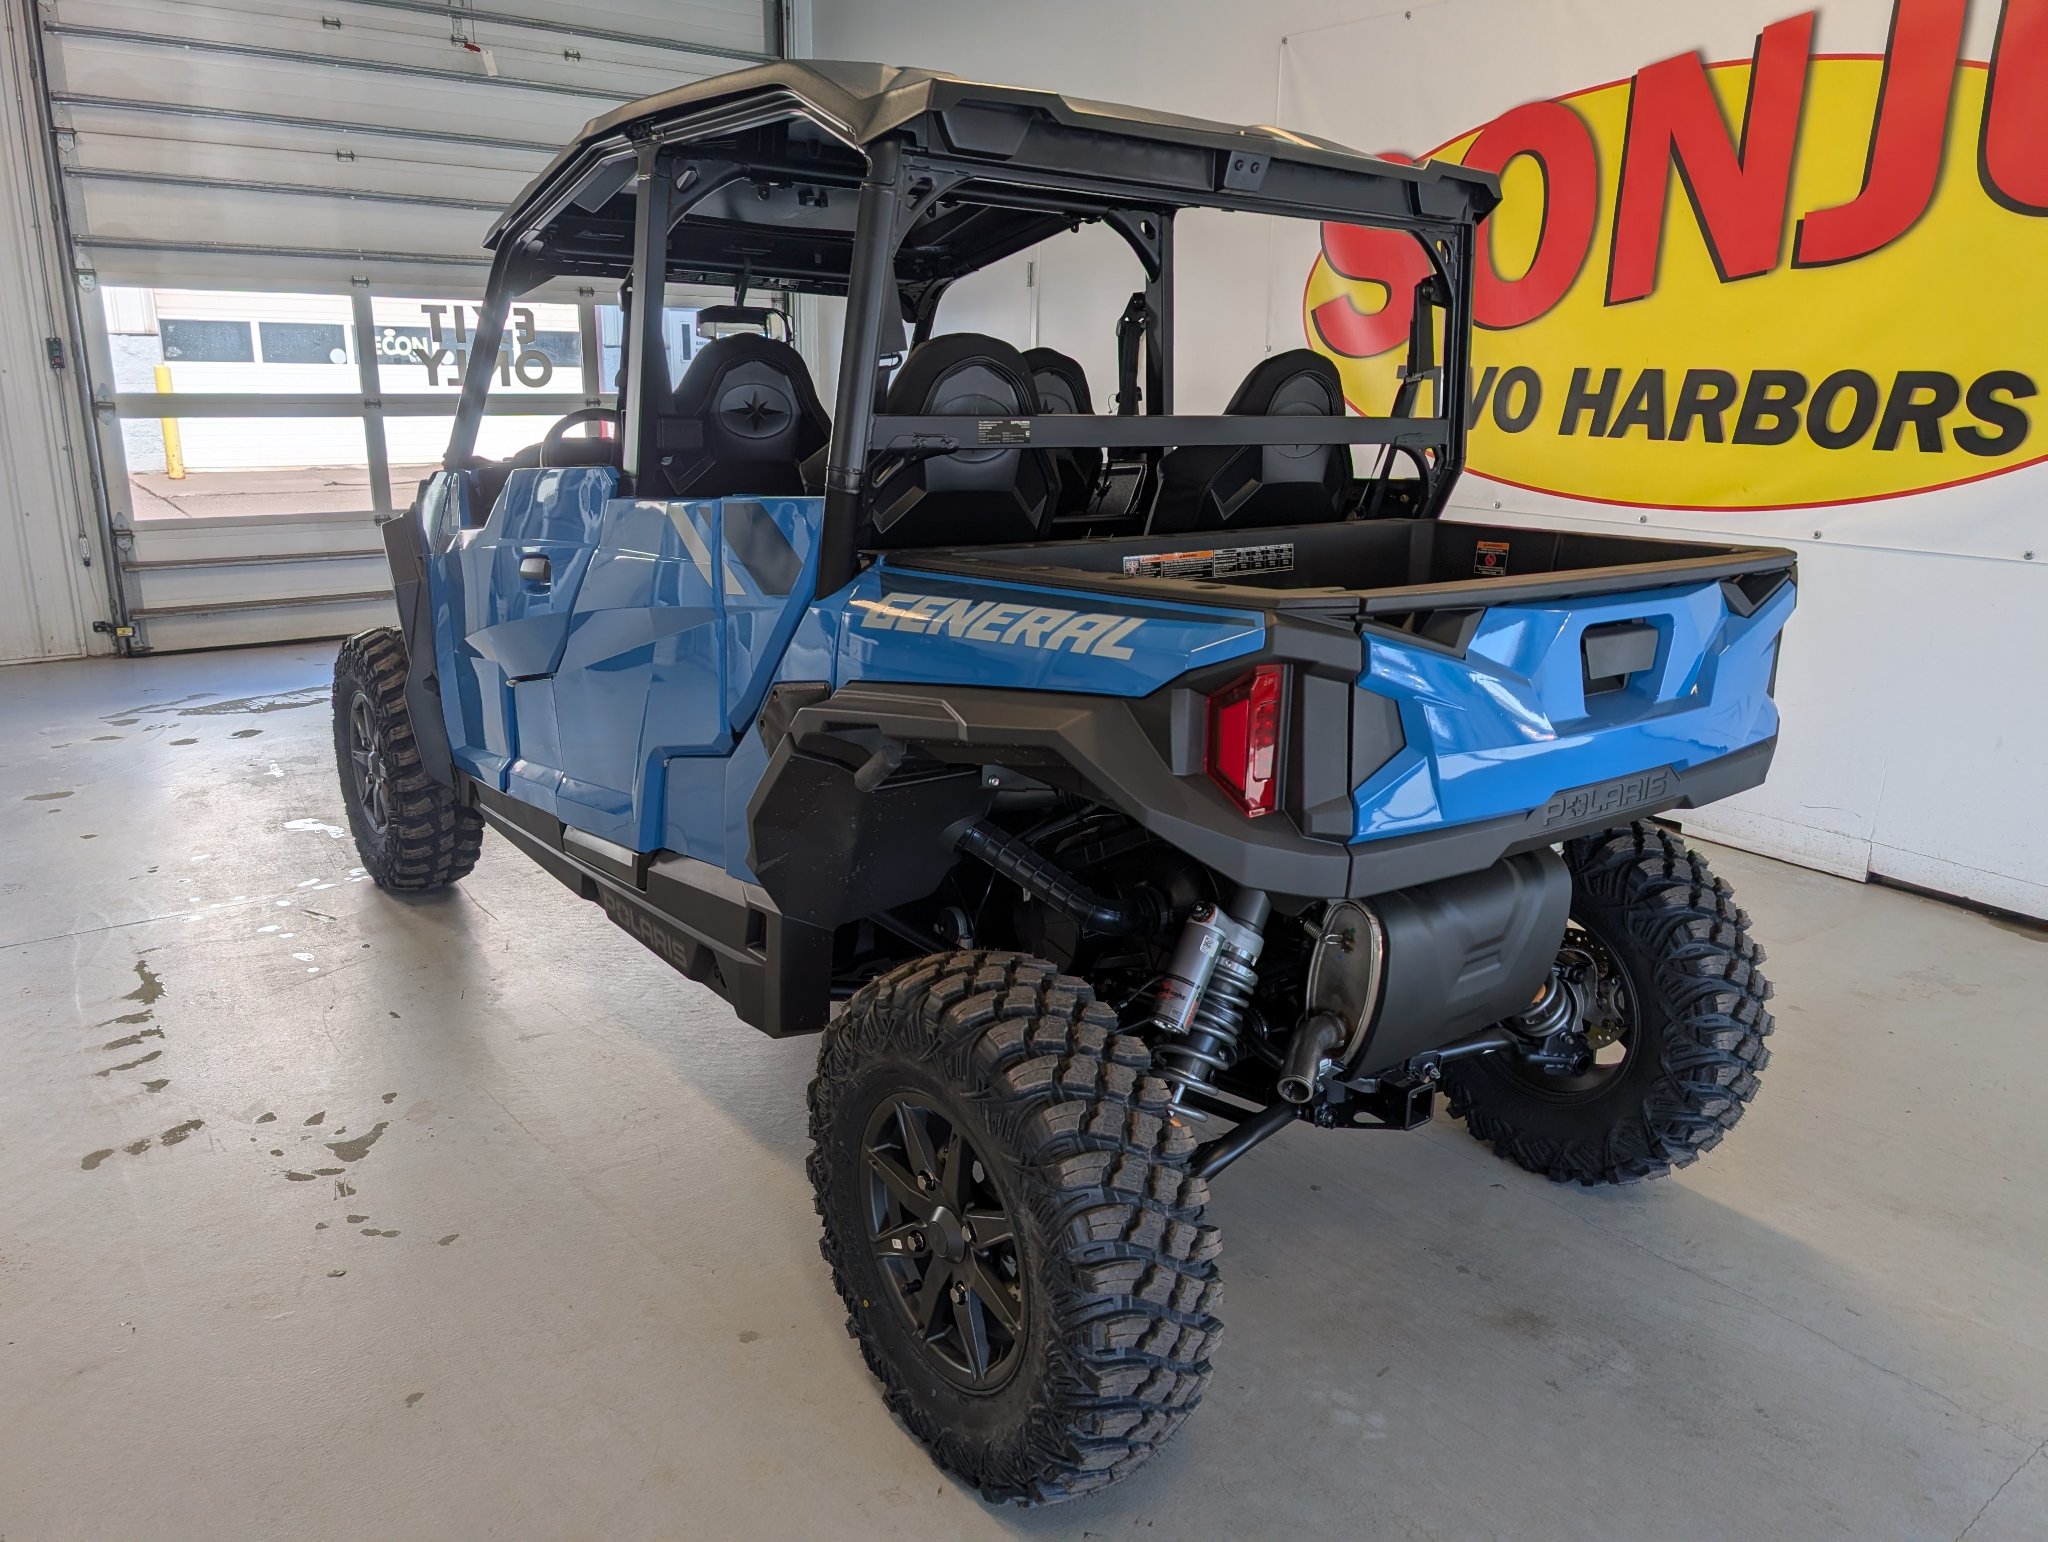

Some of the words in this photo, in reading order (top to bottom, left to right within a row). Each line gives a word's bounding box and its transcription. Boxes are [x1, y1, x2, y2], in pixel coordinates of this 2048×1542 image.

[1558, 367, 2039, 457] HARBORS
[859, 592, 1147, 661] GENERAL
[1543, 769, 1669, 828] POLARIS
[603, 894, 688, 968] POLARIS
